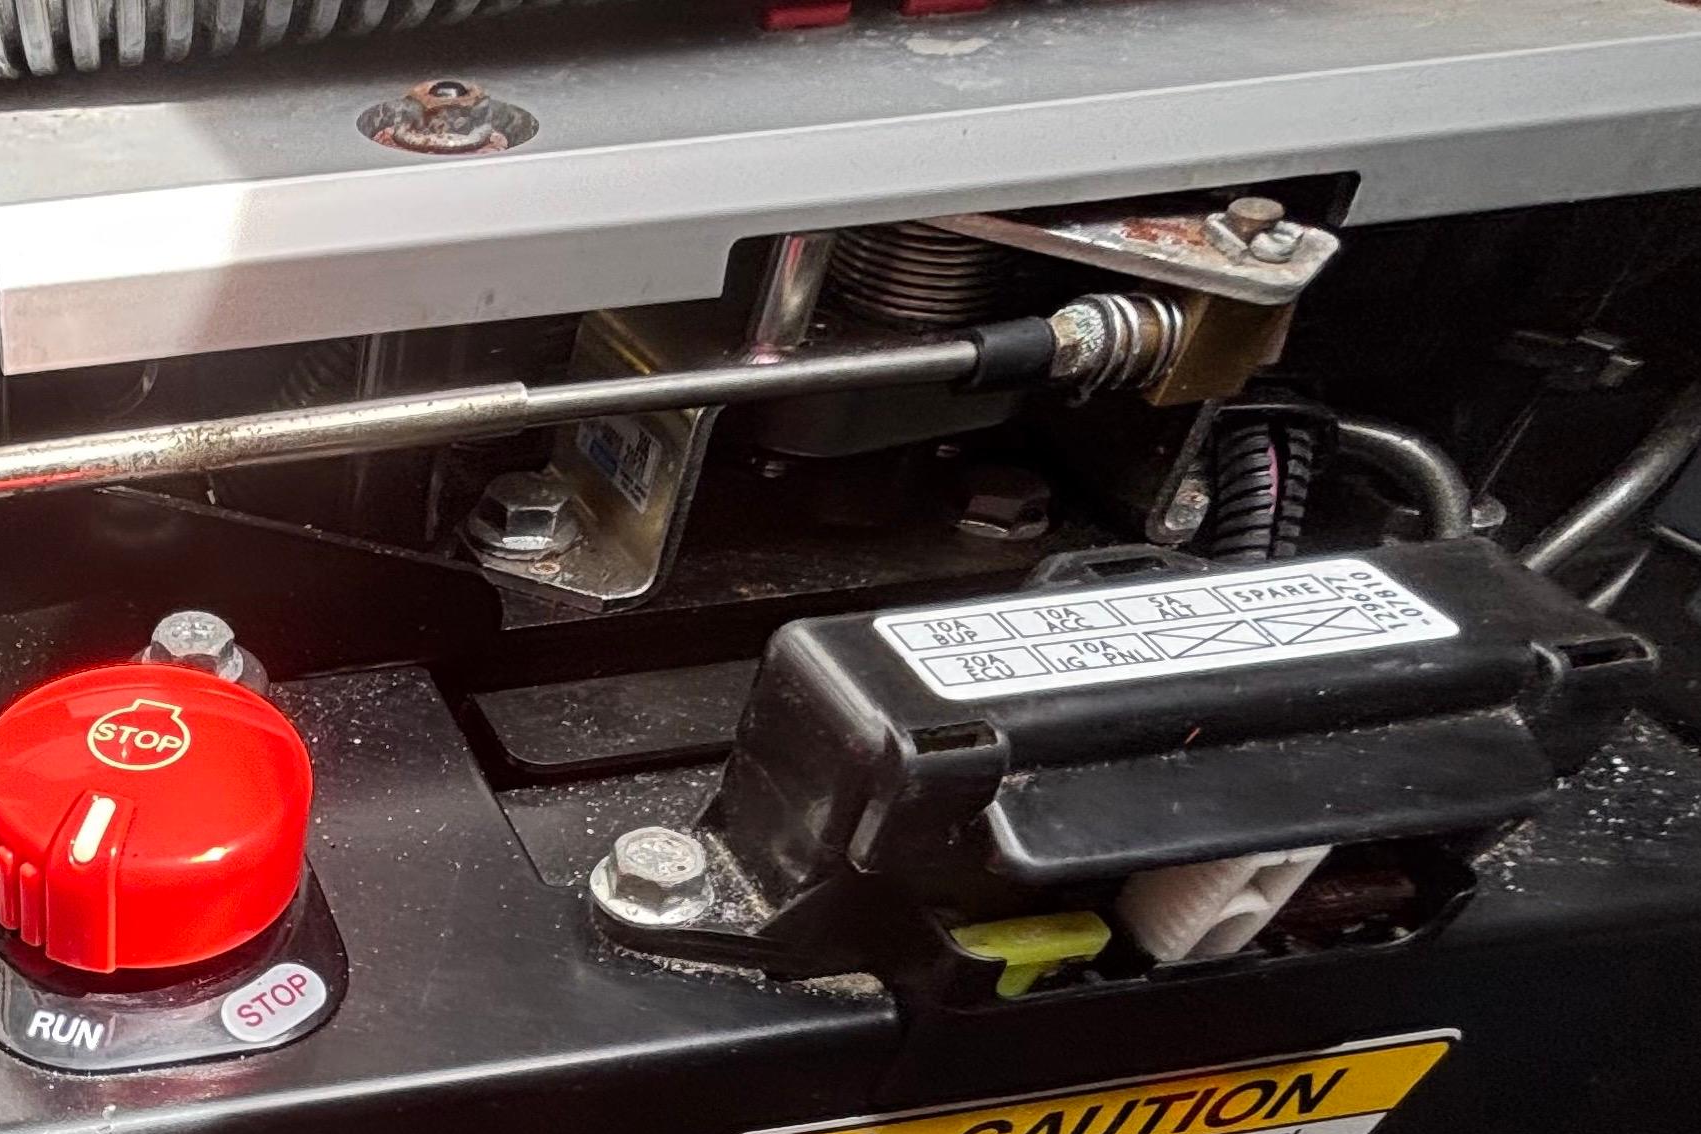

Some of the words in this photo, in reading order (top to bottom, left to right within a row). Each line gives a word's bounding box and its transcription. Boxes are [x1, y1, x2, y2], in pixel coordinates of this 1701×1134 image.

[1148, 592, 1182, 608] 5A
[1233, 582, 1320, 603] SPARE
[1159, 603, 1199, 620] ALT
[1323, 576, 1408, 631] 129677
[1034, 606, 1079, 622] 10A
[923, 618, 970, 635] 10A
[1047, 616, 1094, 635] ACC
[932, 630, 978, 647] BUP
[1070, 640, 1119, 656] 10A
[956, 653, 1005, 670] 20A
[1057, 655, 1086, 672] IG
[1101, 648, 1156, 666] PNL
[969, 663, 1015, 683] ECU
[95, 723, 183, 752] STOP
[237, 973, 308, 1027] STOP
[27, 1011, 105, 1050] RUN
